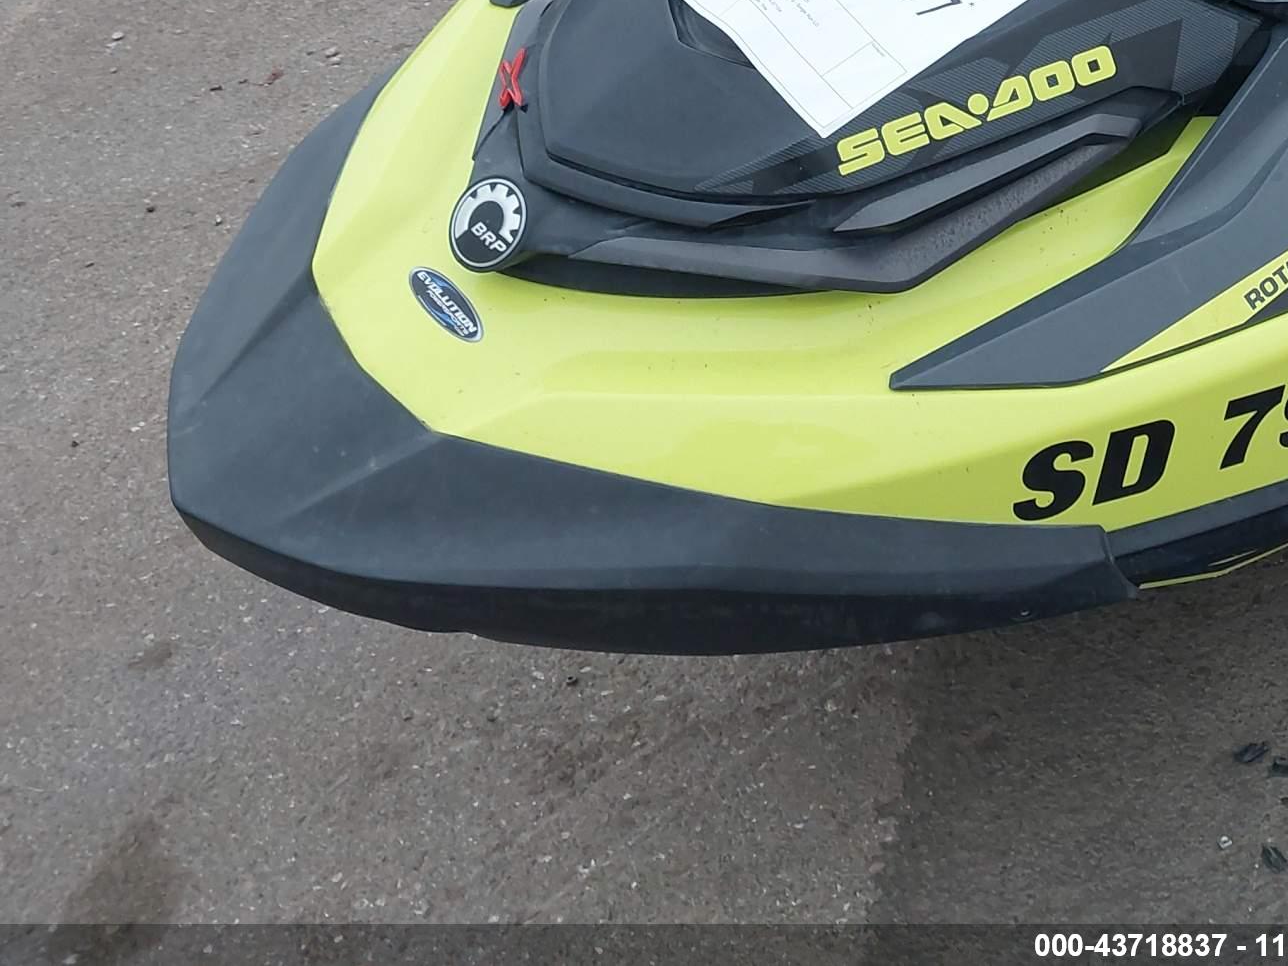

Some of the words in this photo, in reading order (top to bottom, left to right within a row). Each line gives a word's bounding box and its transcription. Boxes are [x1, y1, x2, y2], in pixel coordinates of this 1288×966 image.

[471, 220, 508, 254] BRP
[416, 270, 478, 335] EVOLUTION
[1012, 419, 1175, 521] SD
